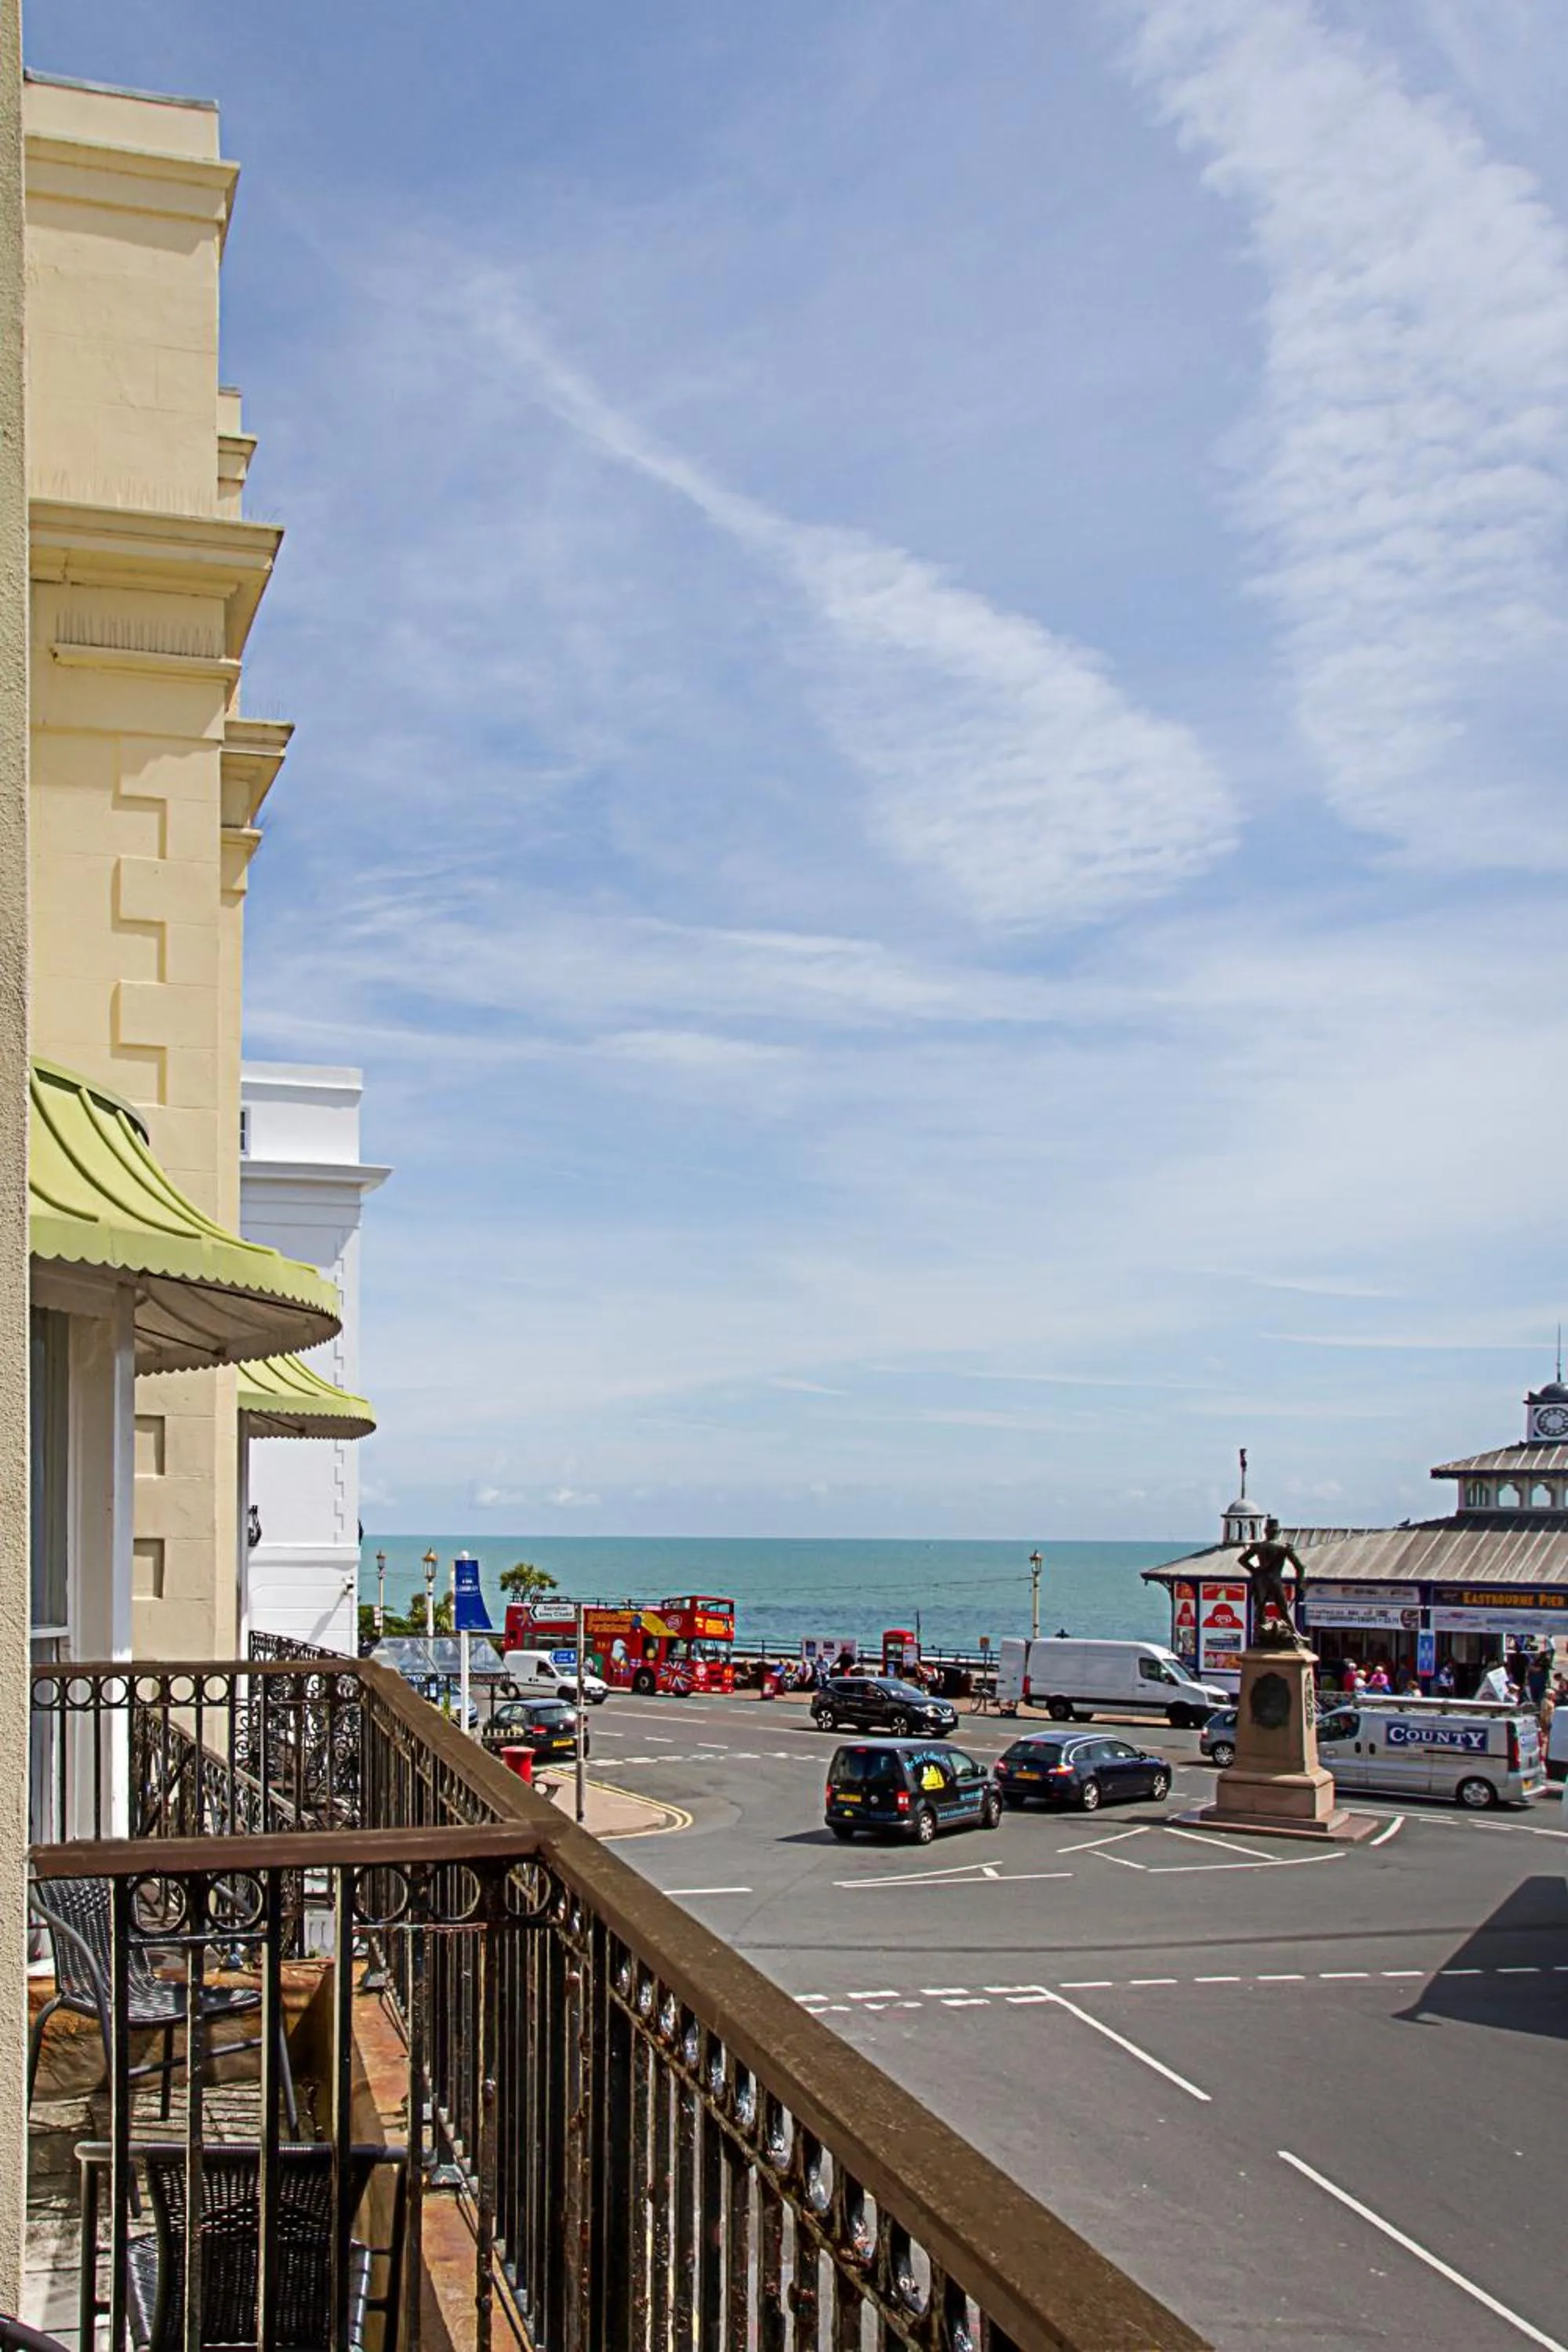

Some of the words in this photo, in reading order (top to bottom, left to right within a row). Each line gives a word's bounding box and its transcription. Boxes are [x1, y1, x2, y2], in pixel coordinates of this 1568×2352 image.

[1462, 1592, 1534, 1606] EASTBOURNE
[1538, 1592, 1565, 1607] PIER
[1388, 1727, 1484, 1748] COUNTY
